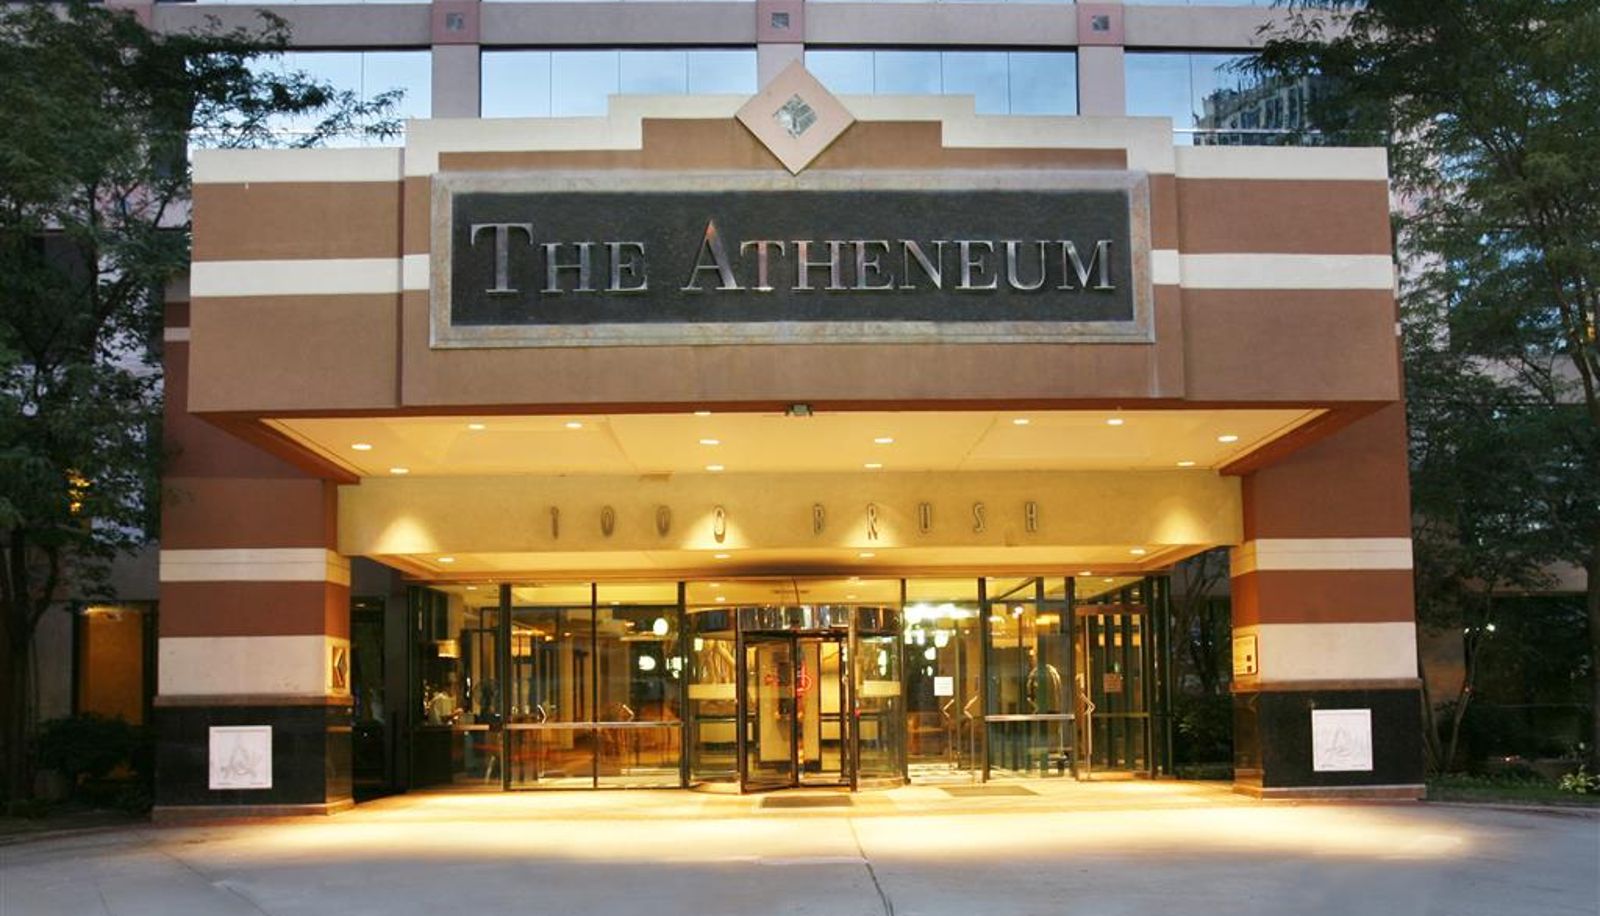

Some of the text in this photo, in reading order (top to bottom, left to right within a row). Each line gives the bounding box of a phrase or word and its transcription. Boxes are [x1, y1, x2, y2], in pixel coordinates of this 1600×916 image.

[470, 218, 1116, 293] THE ATHENEUM
[550, 501, 1039, 543] 1000 BRUSH
